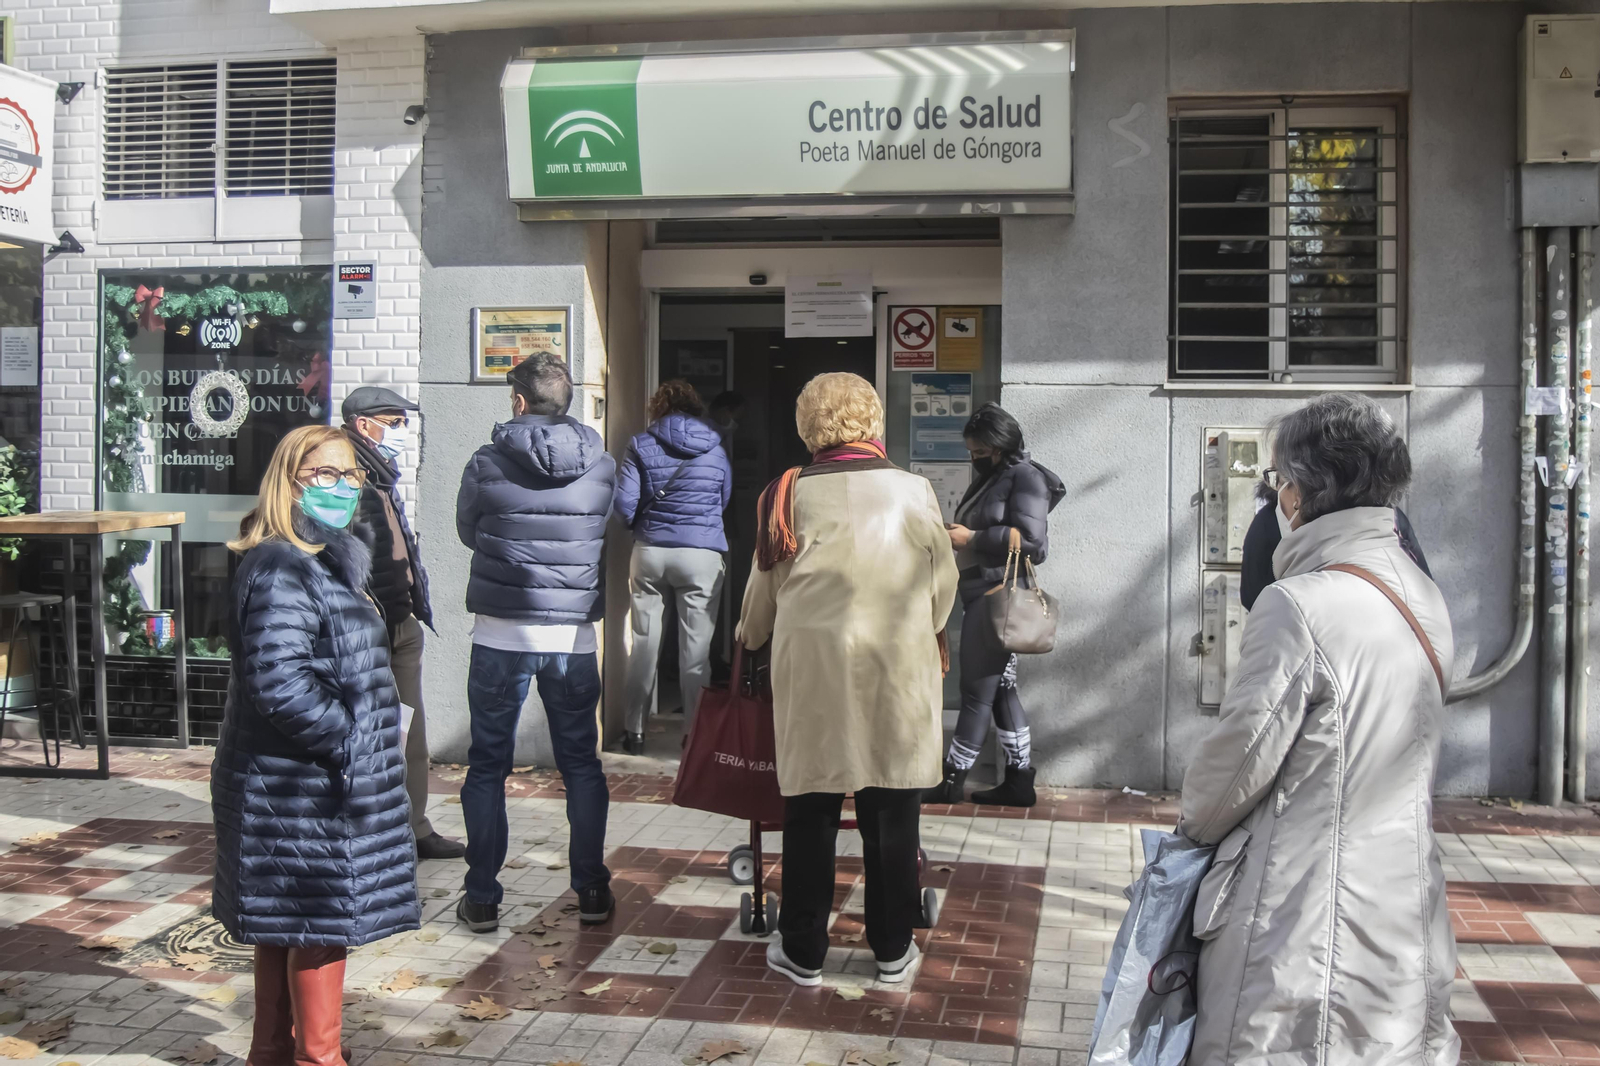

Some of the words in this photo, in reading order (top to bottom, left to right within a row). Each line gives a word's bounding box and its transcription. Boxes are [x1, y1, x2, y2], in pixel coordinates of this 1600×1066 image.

[808, 100, 902, 133] Centro
[913, 97, 948, 130] de
[959, 94, 1041, 129] Salud
[800, 141, 850, 163] Poeta
[858, 138, 926, 161] Manuel
[934, 138, 956, 160] de
[963, 136, 1042, 164] Góngora
[545, 164, 570, 174] JUNTA
[573, 163, 583, 173] DE
[0, 205, 29, 225] ETERÍA
[212, 318, 231, 326] Wi-Fi
[126, 370, 163, 386] LOS
[256, 363, 306, 386] DÍAS
[125, 396, 234, 413] EMPIEAN
[287, 396, 317, 413] UN
[125, 422, 180, 439] BUEN
[124, 449, 236, 471] #muchamiga
